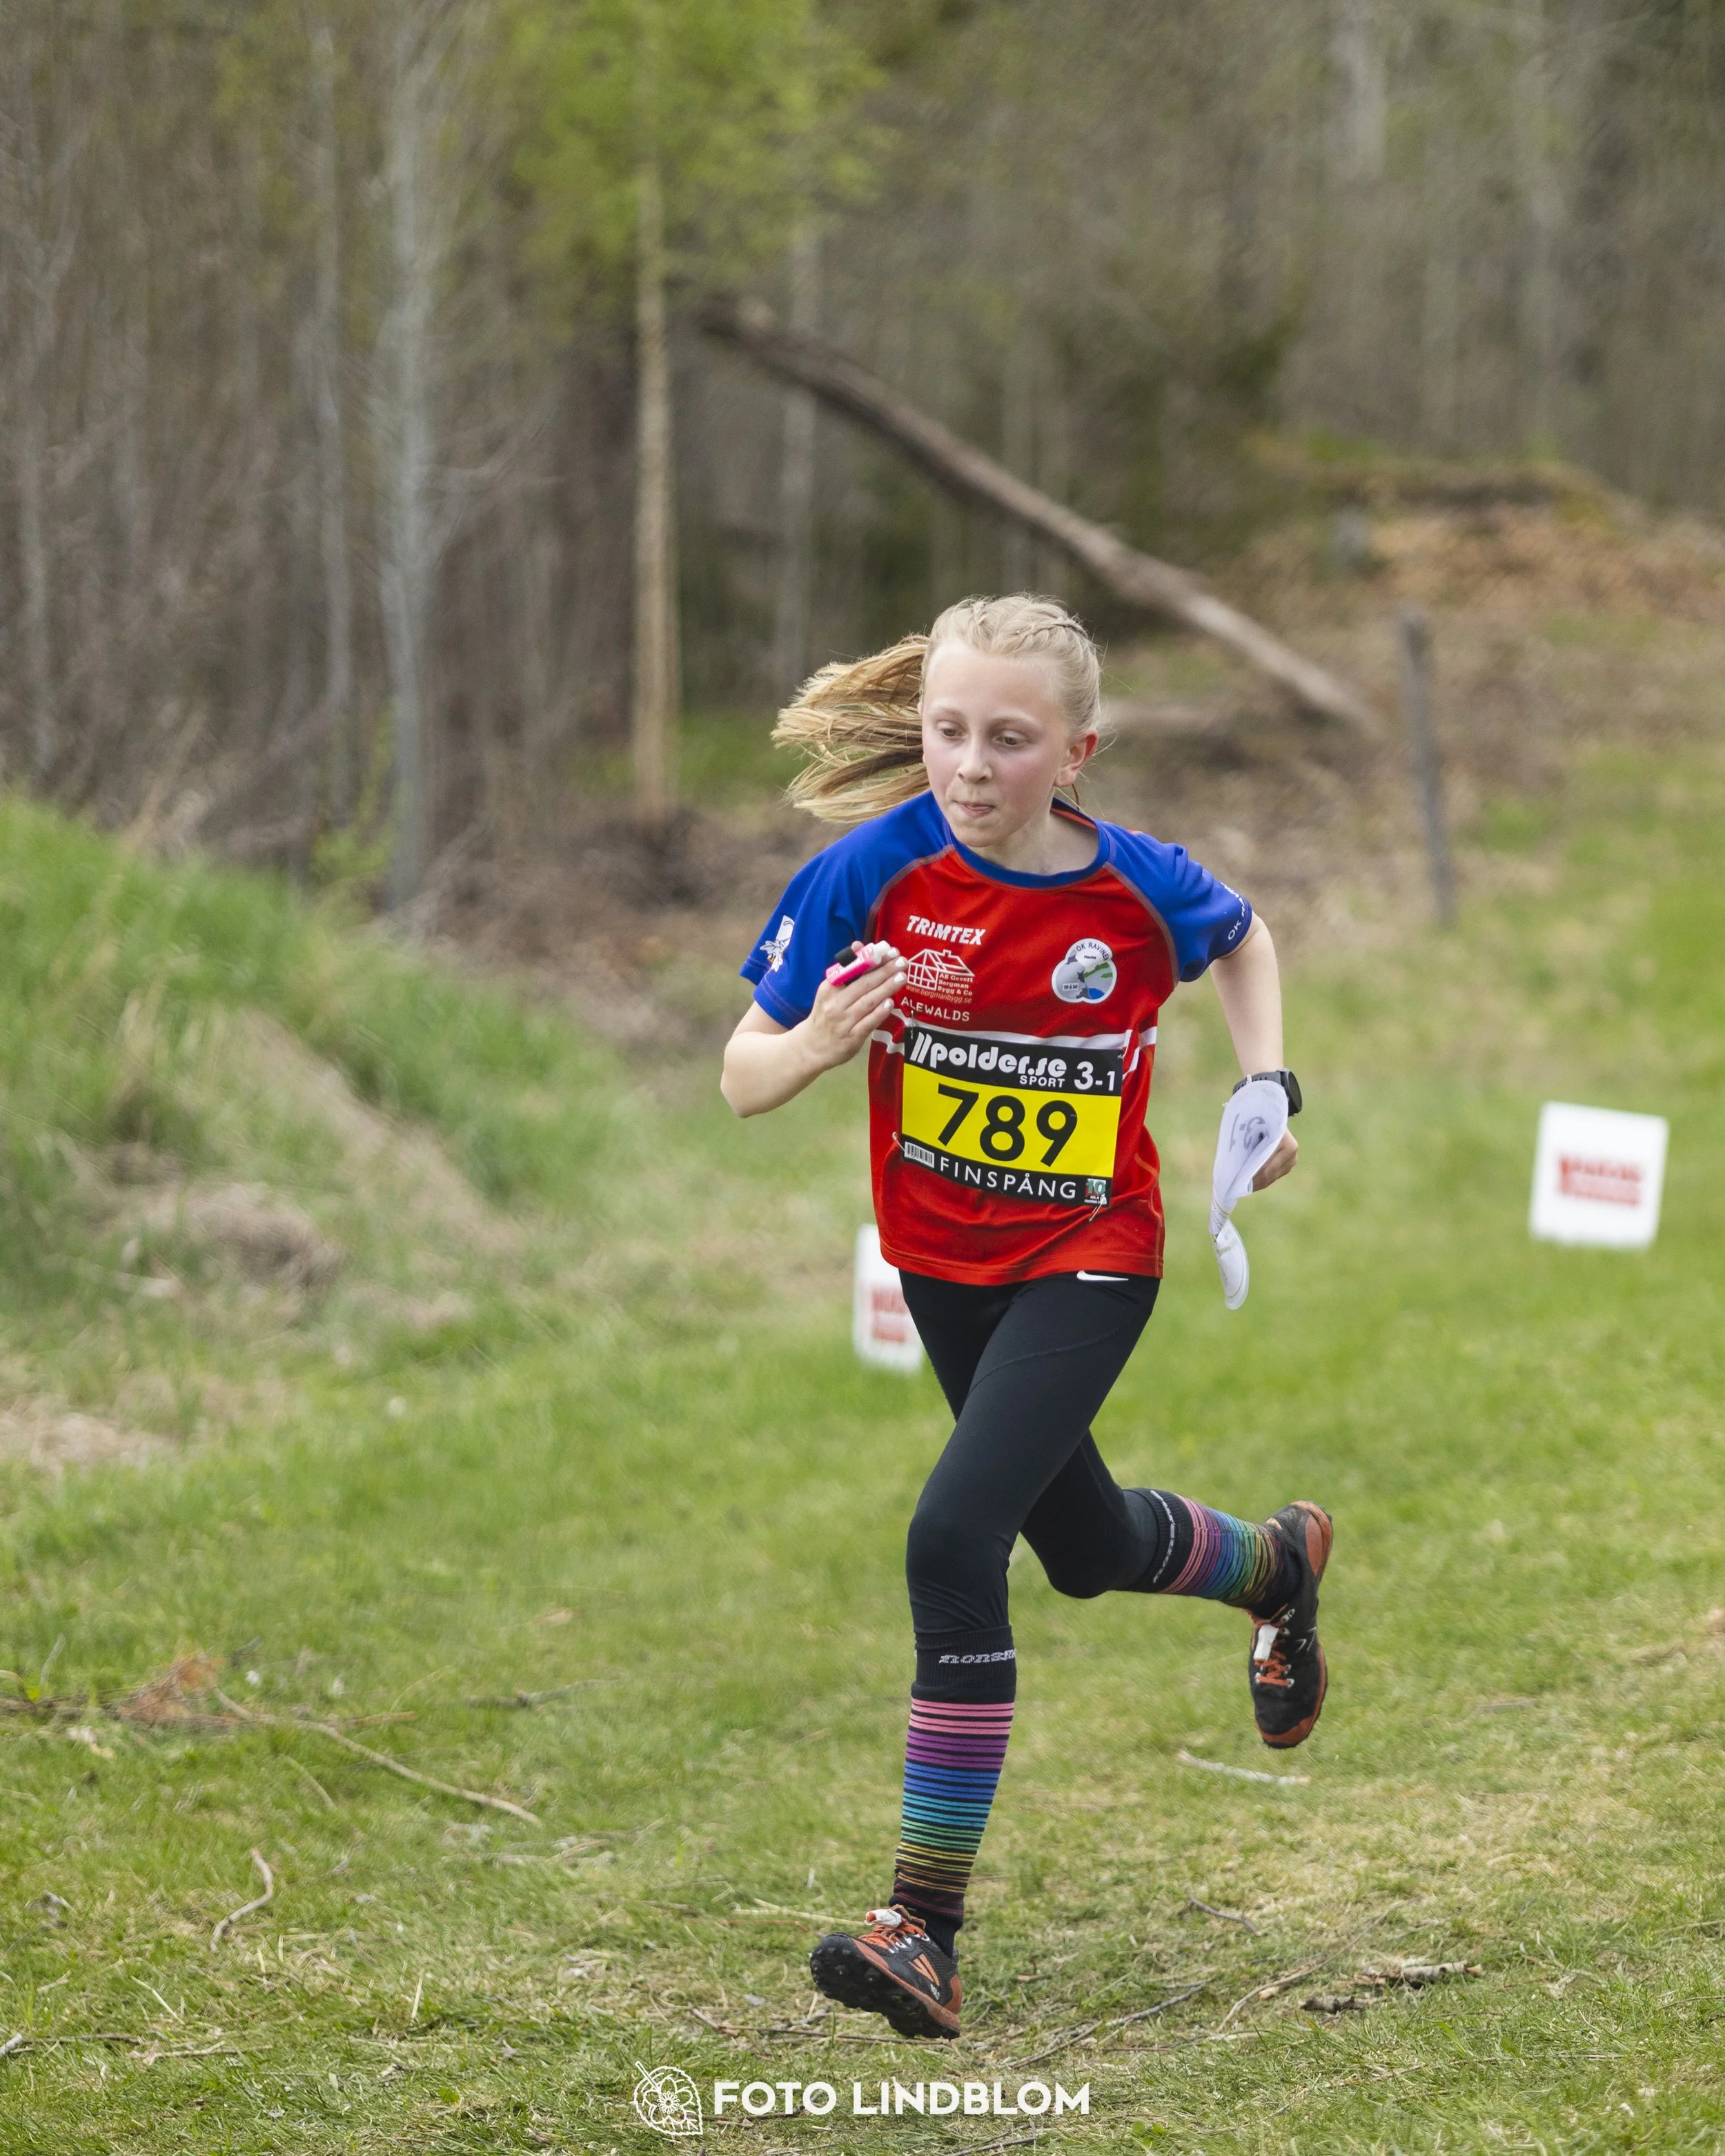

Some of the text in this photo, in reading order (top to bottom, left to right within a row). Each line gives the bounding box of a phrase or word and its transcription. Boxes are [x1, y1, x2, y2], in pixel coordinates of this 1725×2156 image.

[906, 914, 987, 946] TRIMTEX
[1228, 919, 1241, 940] OK
[1076, 942, 1086, 951] OK
[937, 985, 955, 994] Bygg
[938, 979, 969, 989] Bergman
[900, 996, 970, 1022] ALEWALDS
[1019, 1074, 1066, 1088] SPORT
[1074, 1060, 1116, 1091] 3-1
[937, 1082, 1078, 1168] 789
[940, 1156, 1077, 1199] FINSPÅNG
[1085, 1180, 1106, 1195] 10
